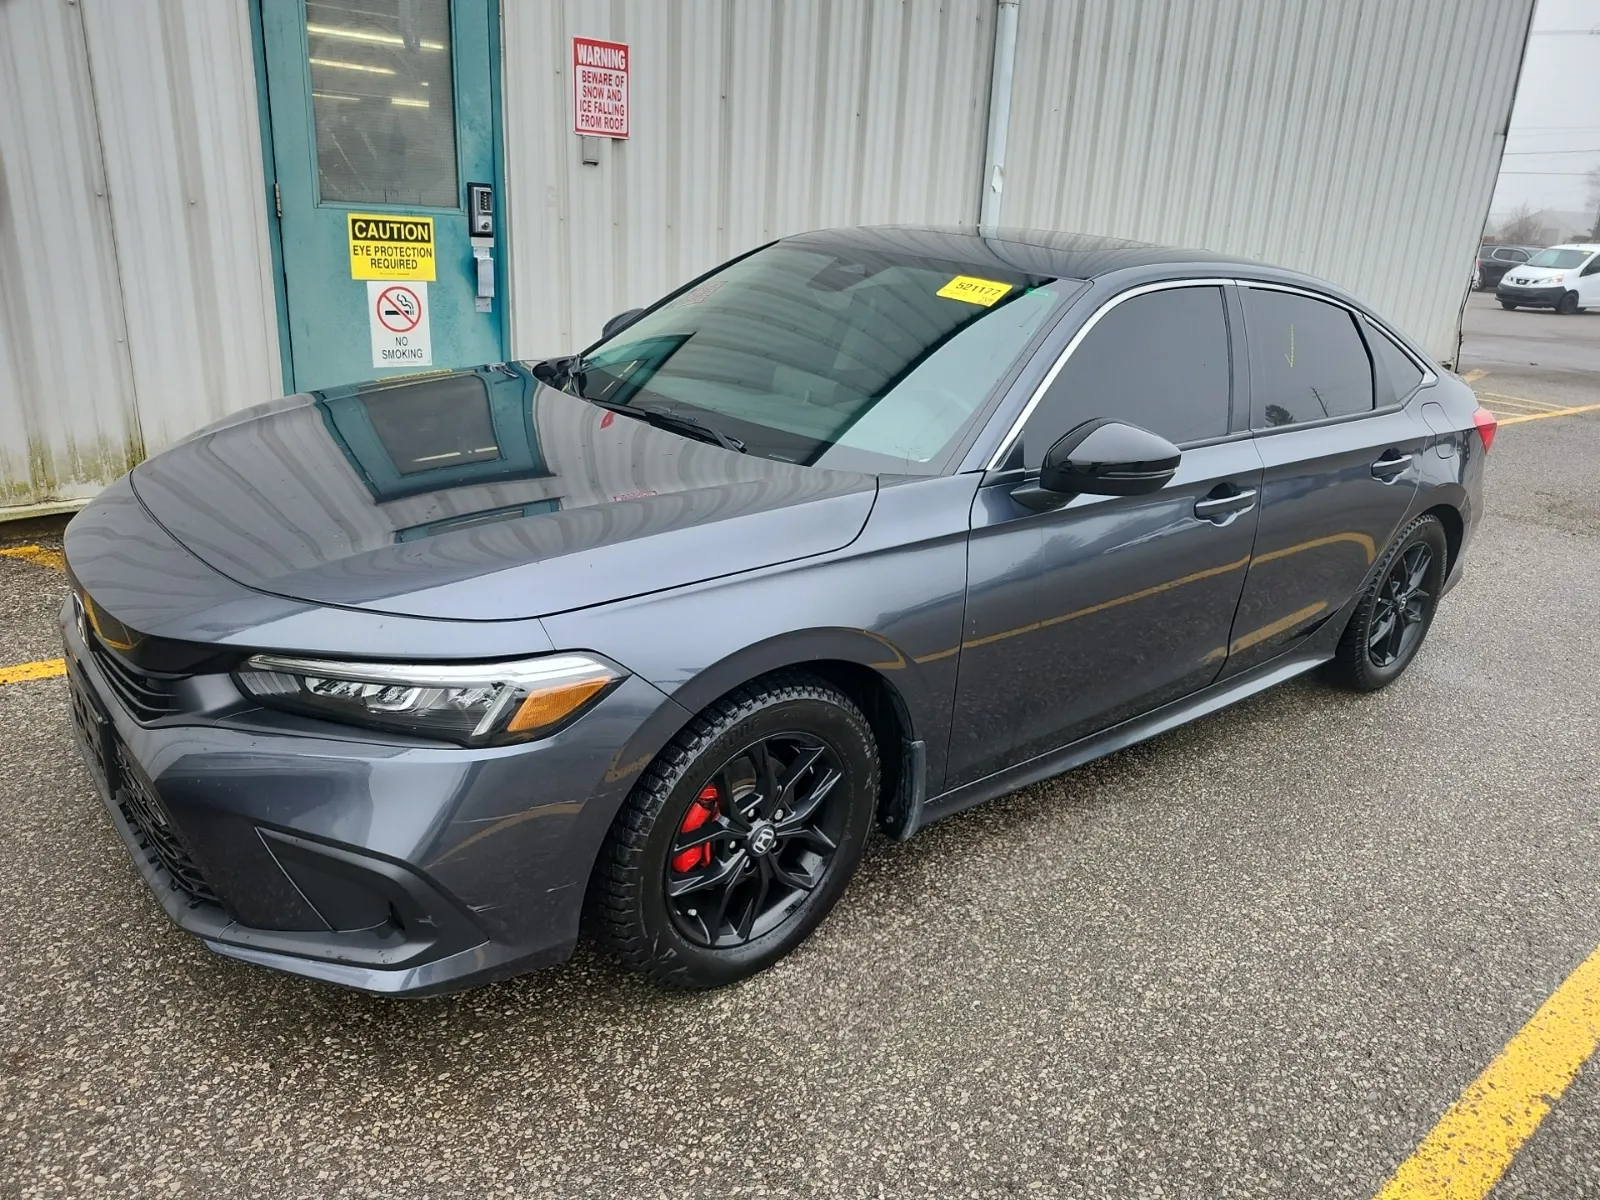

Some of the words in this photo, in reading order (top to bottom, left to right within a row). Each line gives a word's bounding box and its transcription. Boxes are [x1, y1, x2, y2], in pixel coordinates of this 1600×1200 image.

[577, 44, 625, 70] WARNING
[582, 70, 613, 87] BEWARE
[615, 75, 625, 89] OF
[582, 85, 604, 100] SNOW
[606, 88, 622, 102] AND
[580, 99, 592, 113] ICE
[594, 101, 625, 117] FALLING
[580, 114, 602, 128] FROM
[604, 116, 624, 131] ROOF
[354, 221, 429, 241] CAUTION
[353, 245, 372, 256] EYE
[374, 245, 432, 258] PROTECTION
[370, 258, 418, 270] REQUIRED
[955, 282, 1001, 296] 521177
[395, 336, 409, 347] NO
[381, 348, 423, 360] SMOKING
